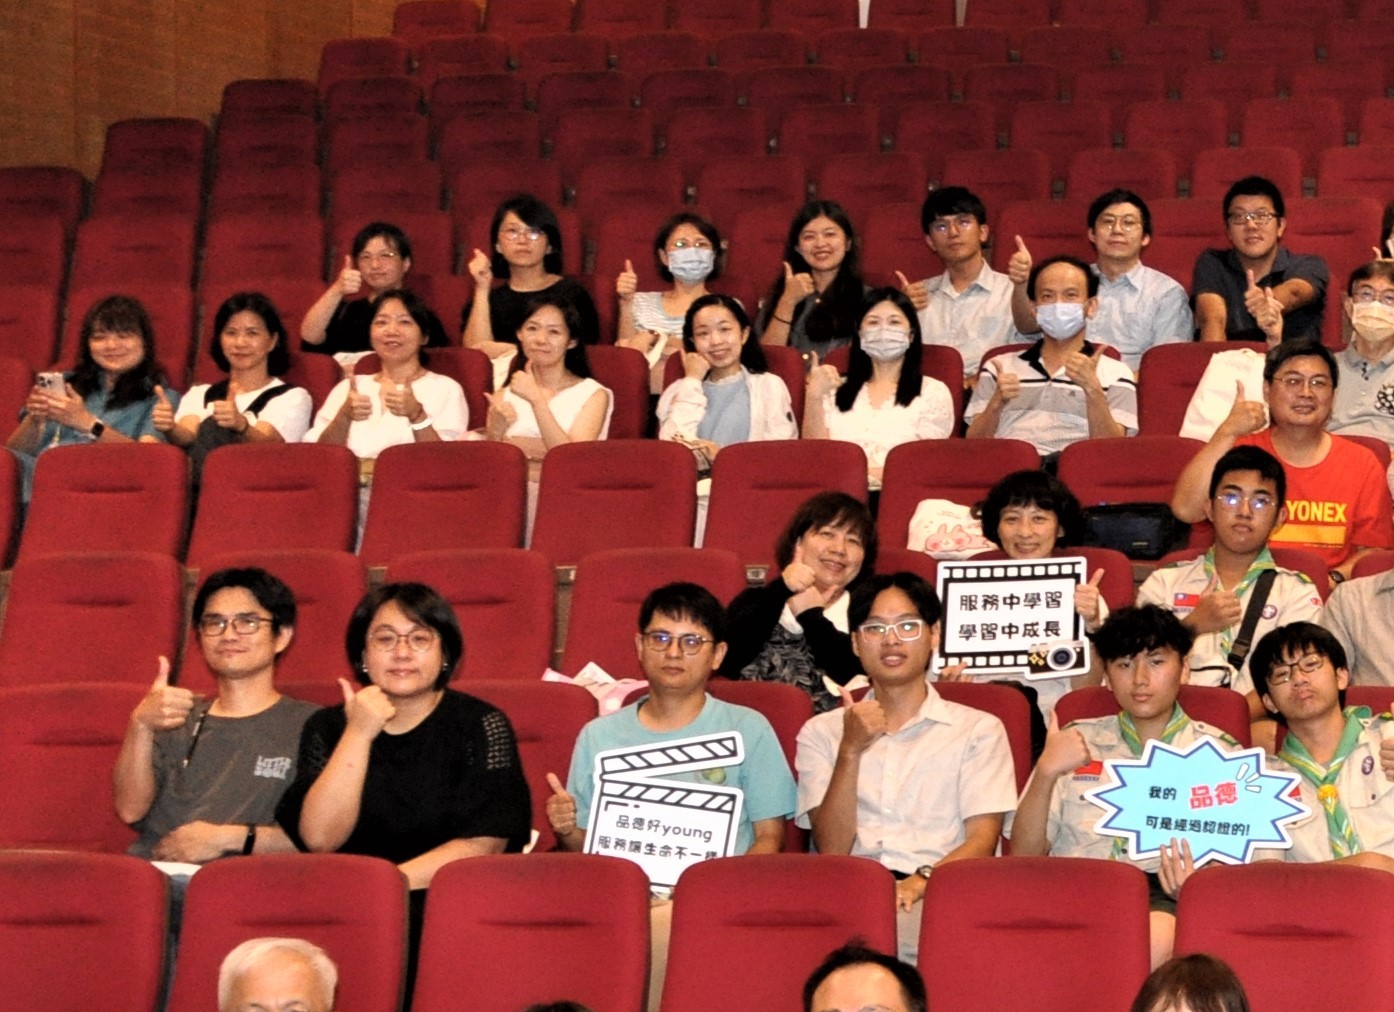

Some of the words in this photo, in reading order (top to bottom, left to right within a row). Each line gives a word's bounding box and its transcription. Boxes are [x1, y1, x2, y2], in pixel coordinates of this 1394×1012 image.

[1285, 500, 1348, 523] YONEX
[959, 590, 1063, 611] 服務中學習
[958, 620, 1061, 641] 學習中成長
[1148, 785, 1177, 800] 我的
[1189, 781, 1239, 809] 品德
[1145, 814, 1250, 837] 可是經過認證的!
